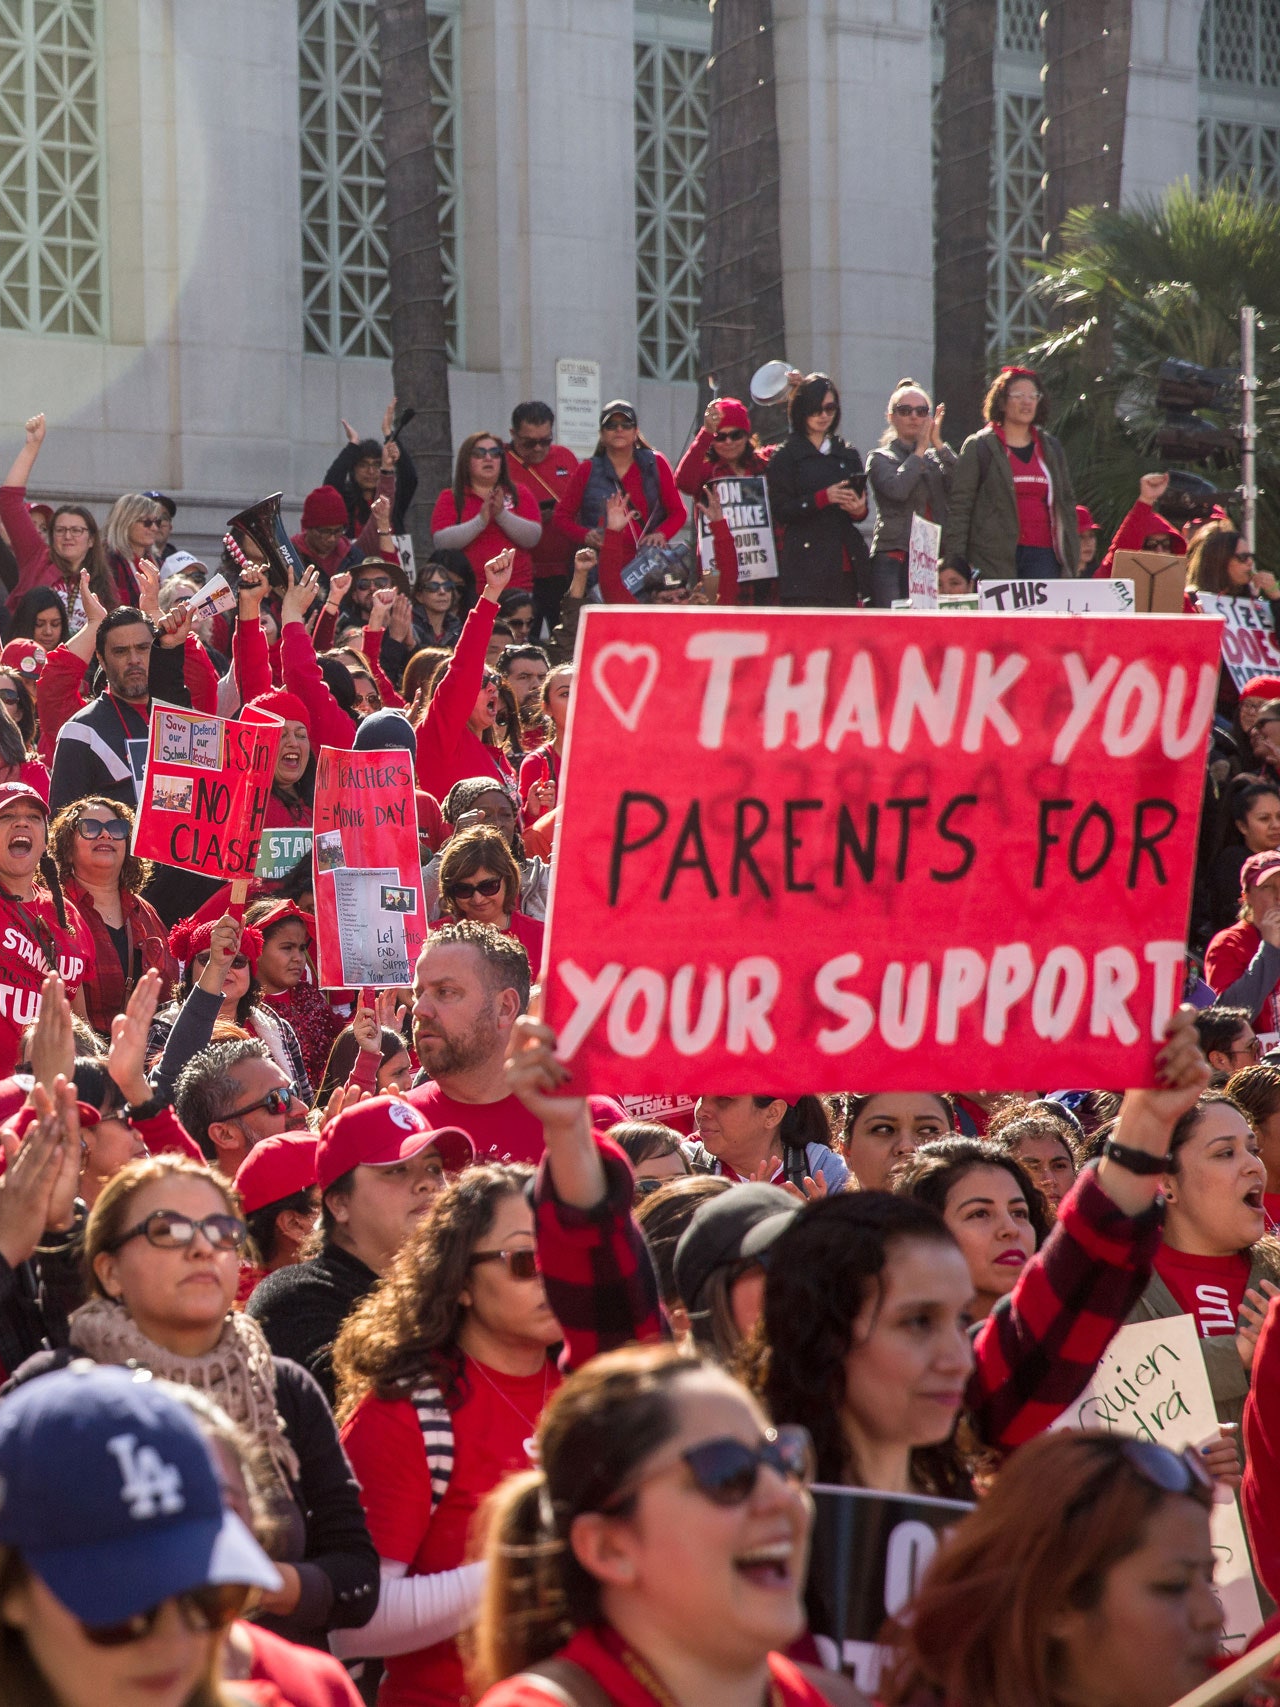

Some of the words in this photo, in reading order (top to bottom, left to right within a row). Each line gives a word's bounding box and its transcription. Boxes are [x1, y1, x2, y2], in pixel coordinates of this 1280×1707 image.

[717, 482, 742, 505] ON
[279, 544, 295, 565] PYLE
[984, 581, 1048, 611] THIS
[685, 630, 1028, 754] THANK
[1051, 652, 1217, 766] YOU
[165, 715, 187, 733] Save
[193, 724, 217, 737] Defend
[169, 733, 182, 743] our
[196, 737, 209, 748] our
[163, 746, 188, 762] Schools
[192, 747, 217, 769] Teachers
[338, 758, 411, 790] TEACHERS
[195, 777, 231, 825] NO
[375, 799, 407, 827] DAY
[171, 823, 261, 874] CLASE
[269, 837, 315, 859] STAN
[608, 791, 979, 907] PARENTS
[1032, 798, 1178, 891] FOR
[376, 926, 393, 944] Let
[59, 955, 84, 982] UP
[391, 972, 415, 983] TEACH
[557, 955, 781, 1063] YOUR
[816, 940, 1186, 1055] SUPPORT
[1195, 1284, 1236, 1338] UTL
